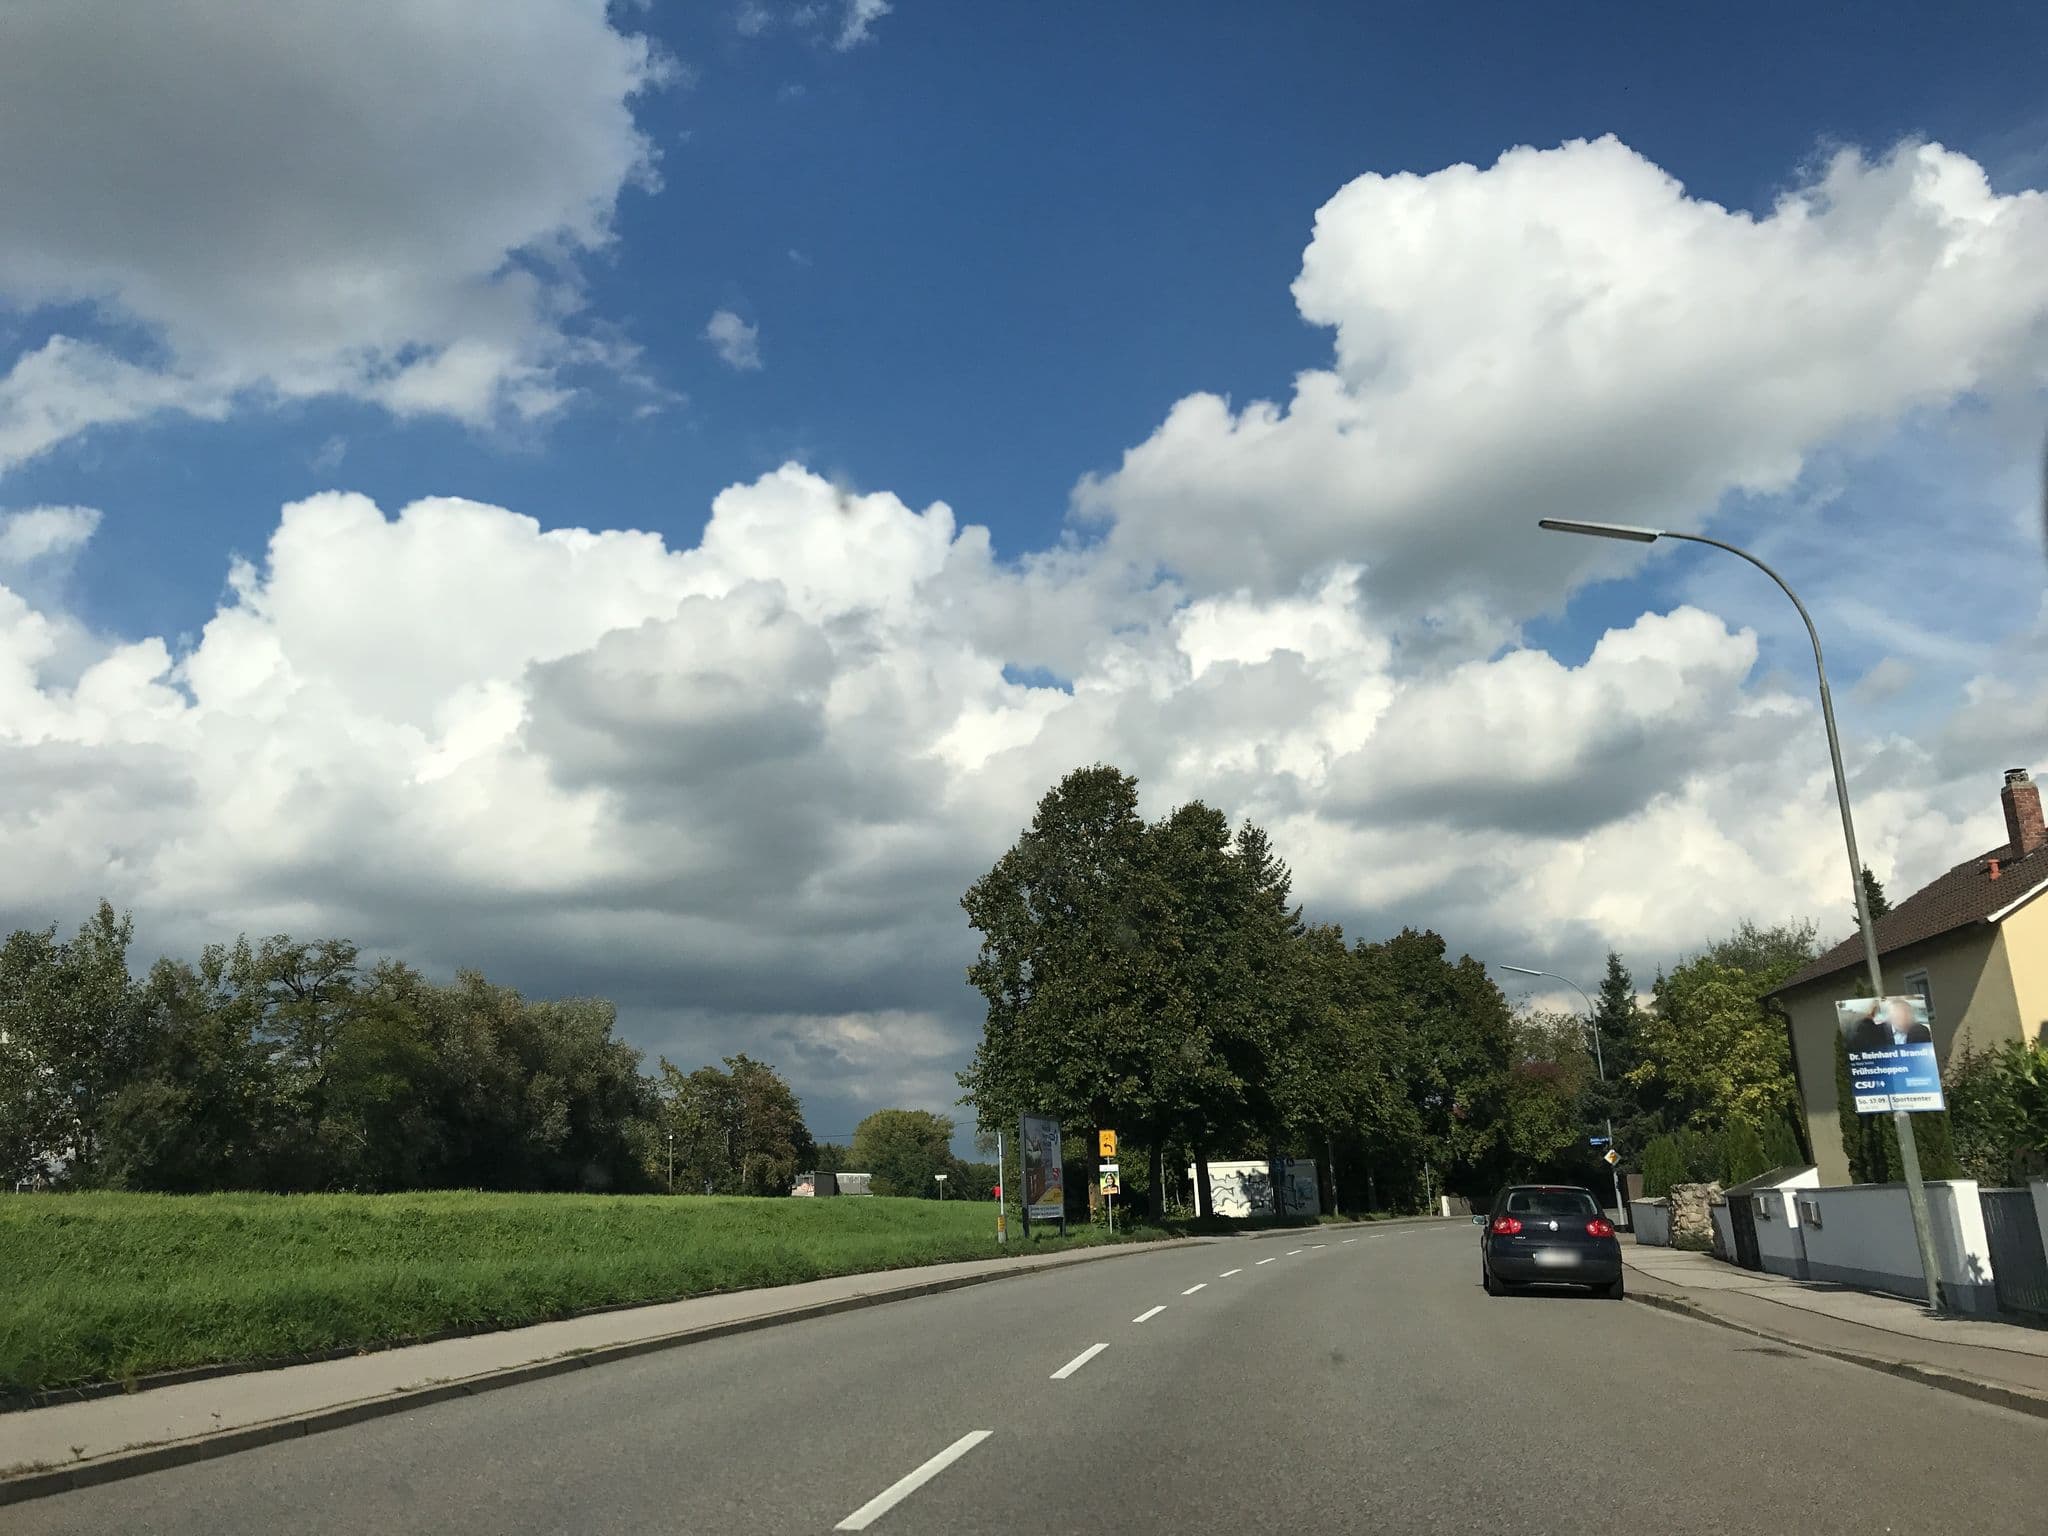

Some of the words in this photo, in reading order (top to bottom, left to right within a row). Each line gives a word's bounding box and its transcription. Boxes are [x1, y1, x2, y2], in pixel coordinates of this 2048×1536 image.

[1862, 1050, 1898, 1060] Reinhard
[1852, 1066, 1908, 1076] Frühschoppen
[1855, 1080, 1875, 1089] CSU
[1892, 1095, 1931, 1104] Sportcenter
